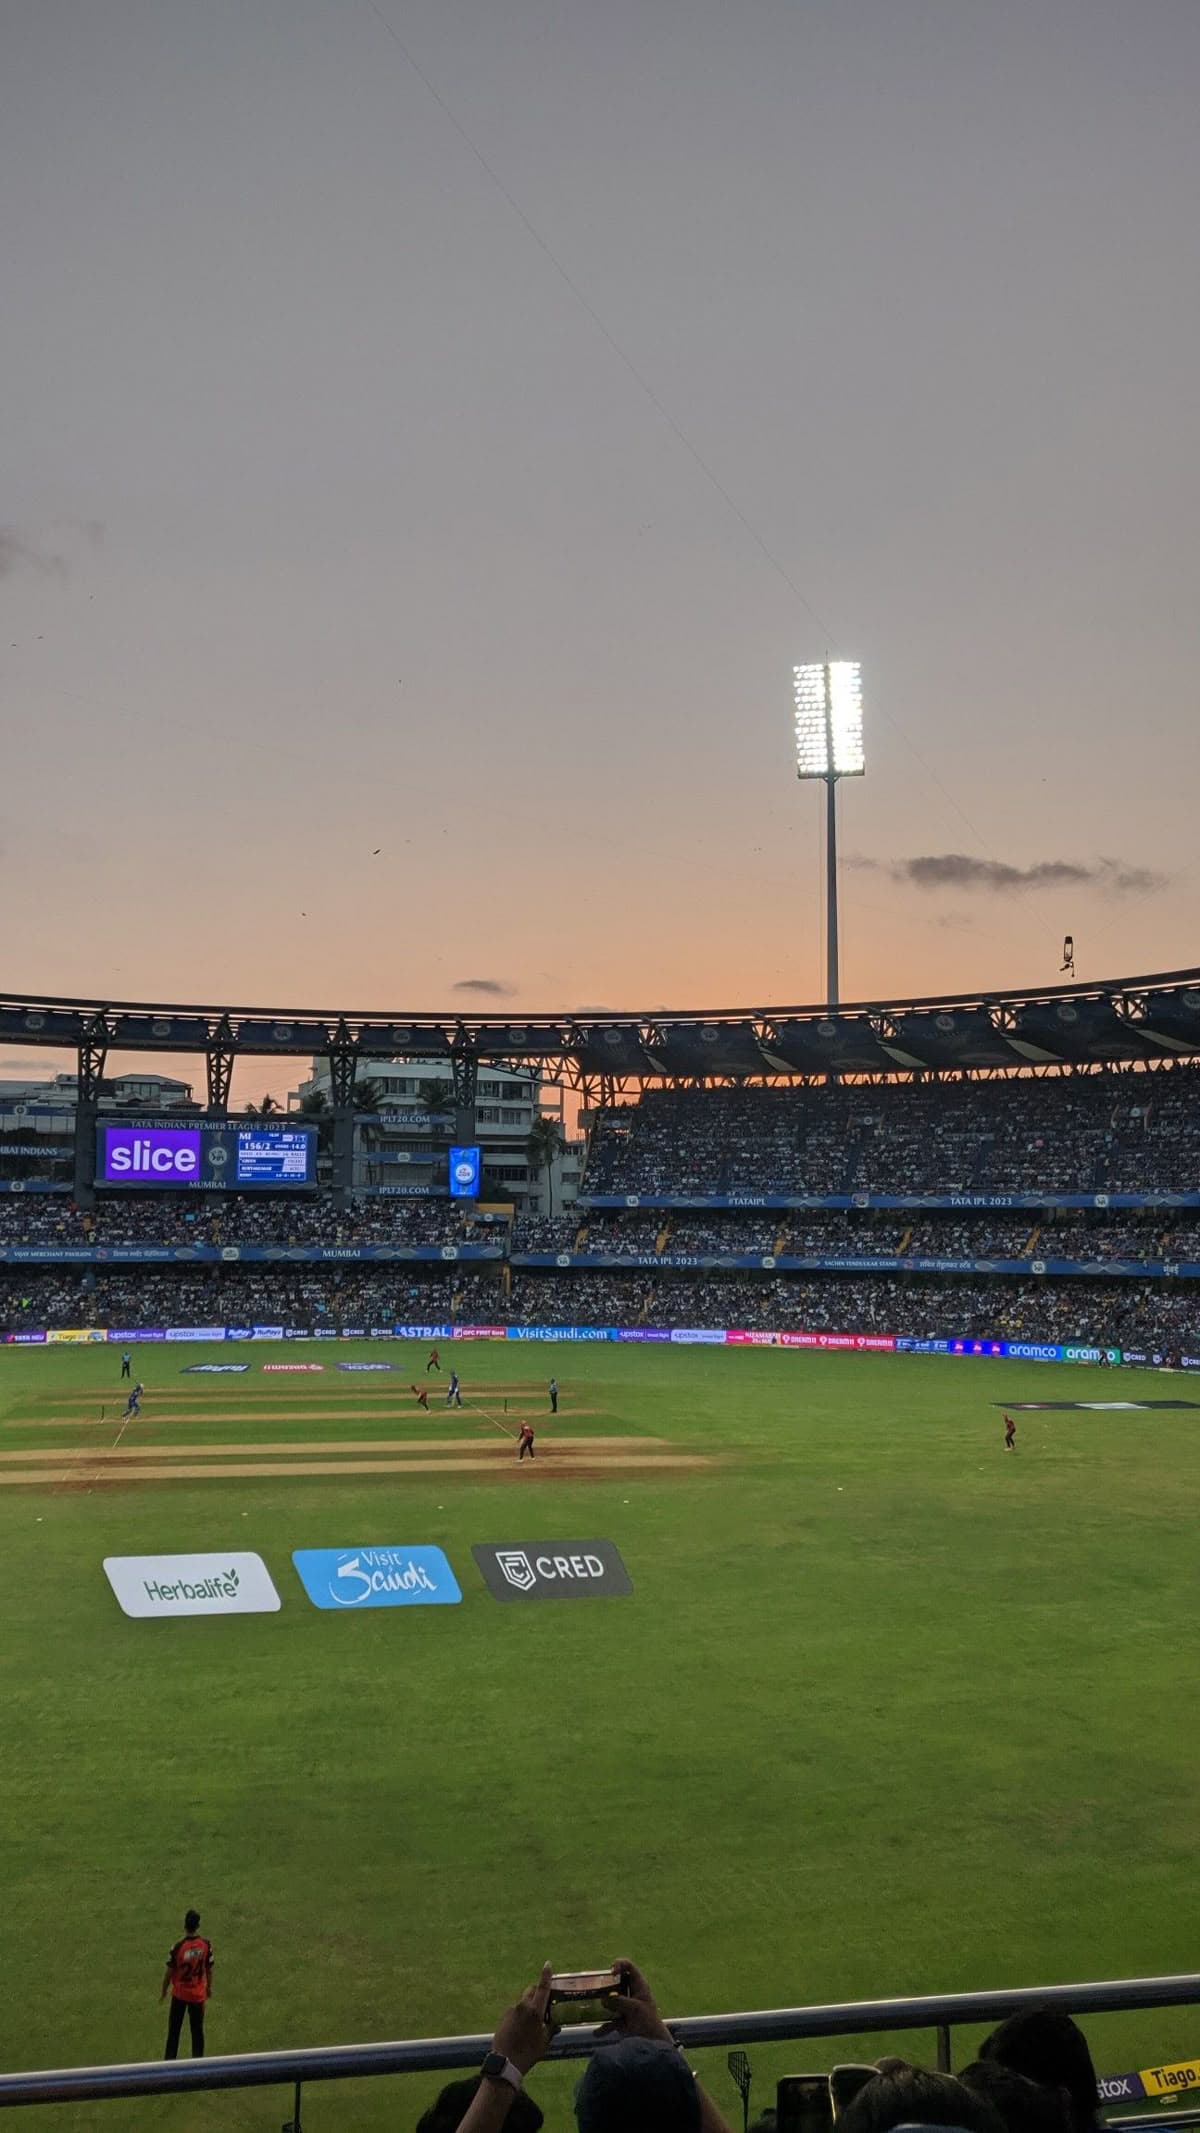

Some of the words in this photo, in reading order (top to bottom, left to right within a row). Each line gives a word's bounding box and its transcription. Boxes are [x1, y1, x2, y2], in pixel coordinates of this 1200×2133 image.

[380, 1115, 430, 1123] IPLT20.COM
[131, 1120, 152, 1128] TATA
[155, 1121, 186, 1129] INDIAN
[189, 1122, 225, 1130] PREMIER
[228, 1123, 259, 1131] LEAGUE
[240, 1132, 251, 1140] MI
[20, 1146, 57, 1156] INDIANS
[245, 1142, 270, 1150] 156/2
[110, 1140, 196, 1171] slice
[188, 1181, 226, 1189] MUMBAI
[379, 1186, 429, 1194] IPLT20.COM
[728, 1198, 767, 1206] #TATAIPL
[950, 1197, 971, 1206] TATA
[973, 1197, 987, 1206] IPL
[990, 1197, 1012, 1206] 2023
[322, 1249, 361, 1258] MUMBAI
[638, 1257, 657, 1265] TATA
[660, 1257, 673, 1265] IPL
[675, 1256, 698, 1265] 2023
[399, 1326, 449, 1337] ASTRAL
[517, 1326, 607, 1339] VisitSaudi.com
[1009, 1345, 1057, 1357] aramco
[1066, 1348, 1116, 1361] aramo
[361, 1550, 402, 1567] Visit
[536, 1555, 604, 1579] CRED
[329, 1557, 438, 1605] Saudi
[143, 1577, 237, 1601] Herbalife
[1151, 2067, 1197, 2089] Tiago
